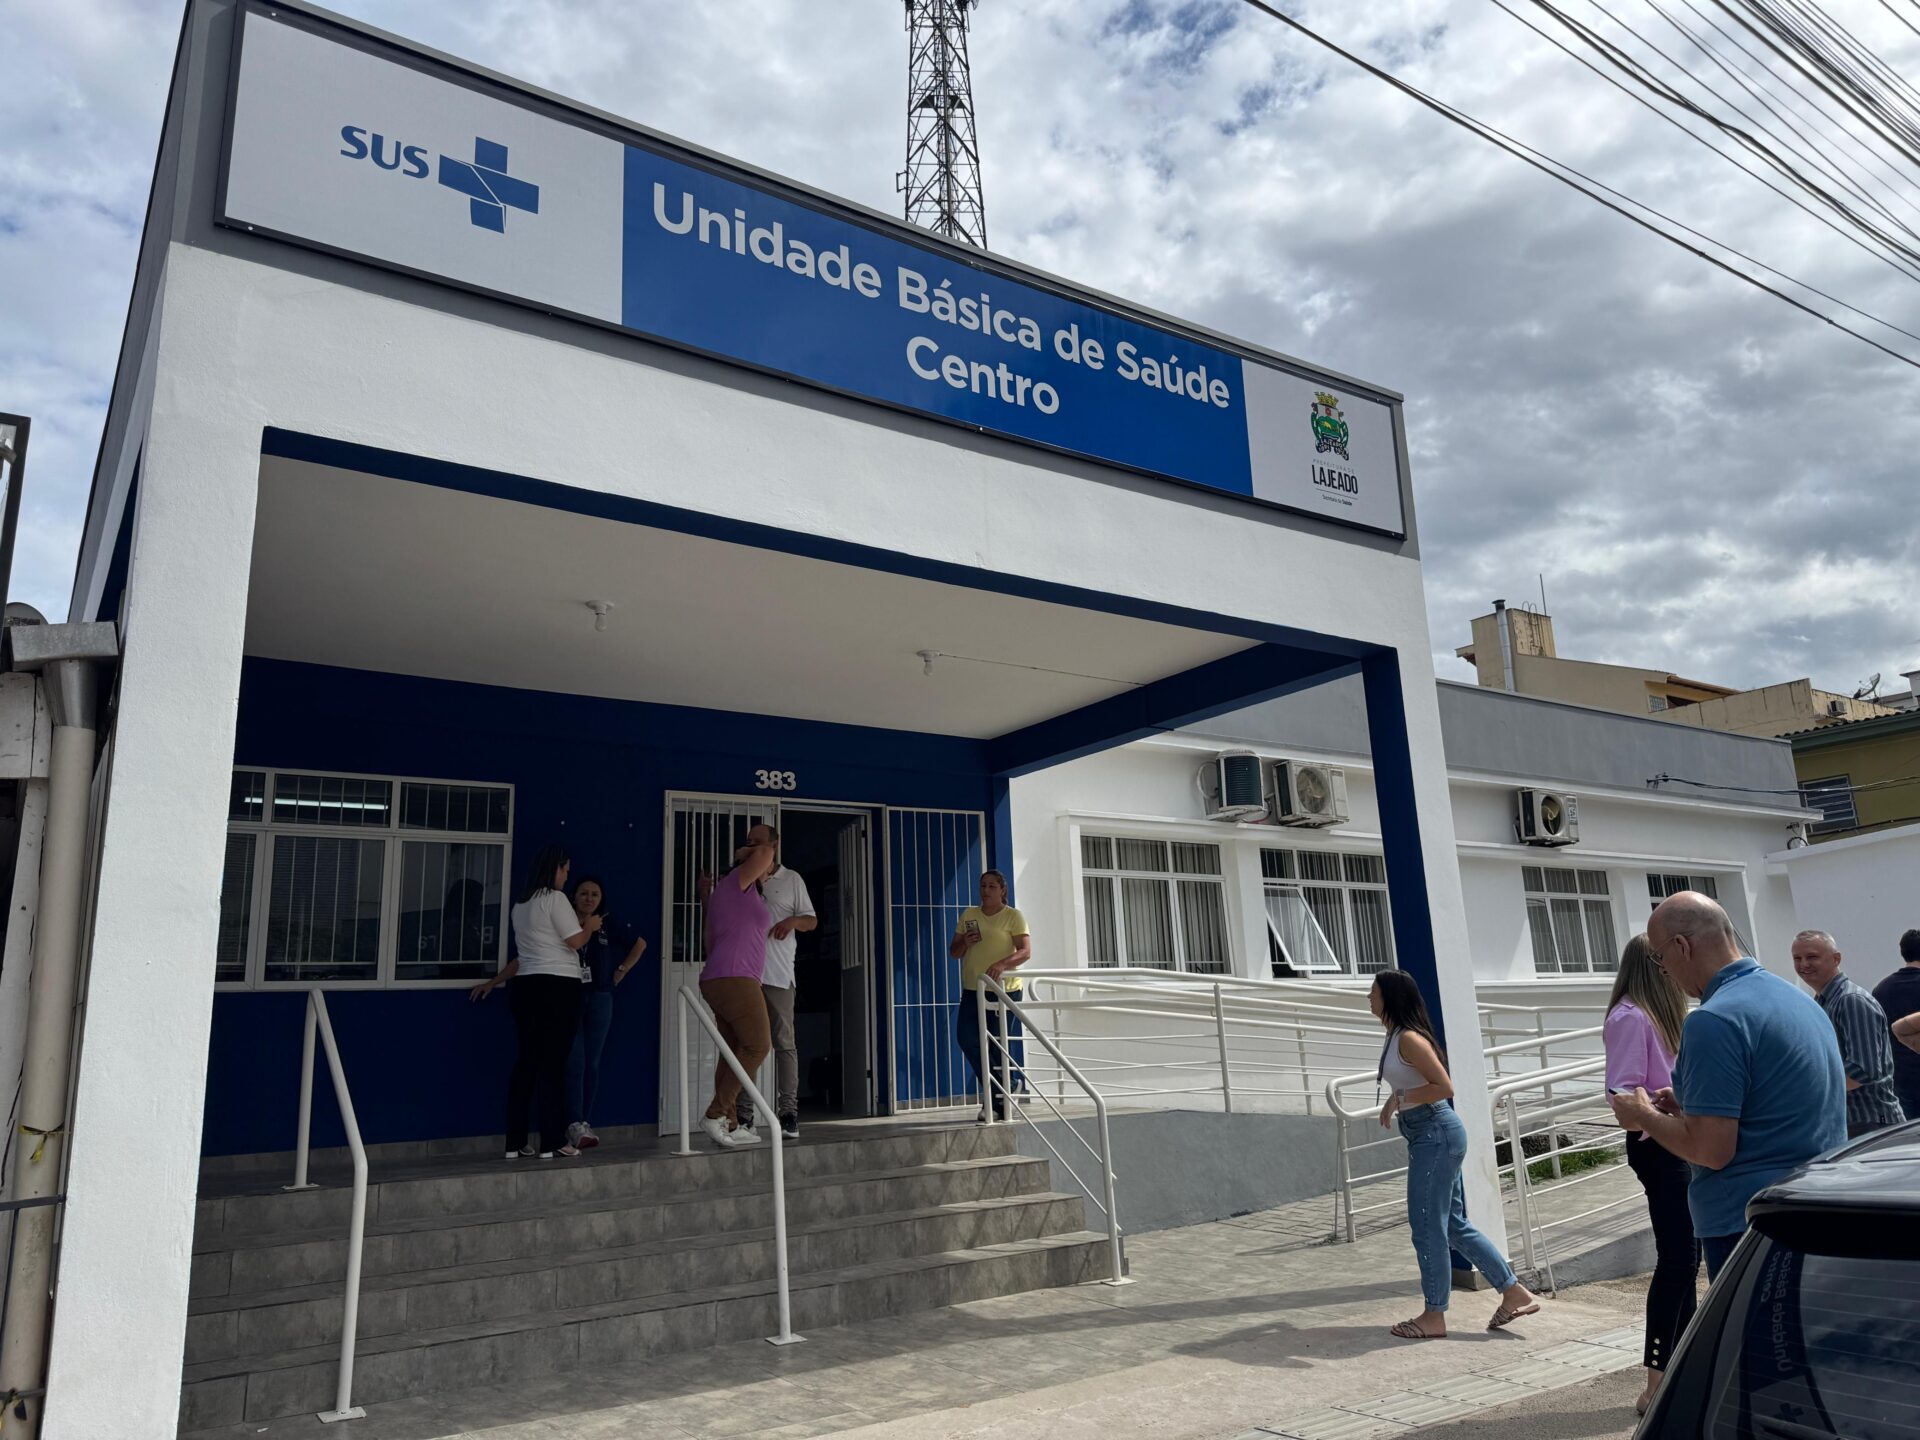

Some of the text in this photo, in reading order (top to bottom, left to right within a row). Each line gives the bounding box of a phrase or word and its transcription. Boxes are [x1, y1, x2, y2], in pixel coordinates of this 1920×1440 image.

[340, 125, 430, 179] SUS
[653, 182, 1230, 408] Unidade Básica de Saúde
[906, 336, 1060, 415] Centro
[1311, 464, 1359, 495] LAJEADO
[755, 769, 797, 791] 383
